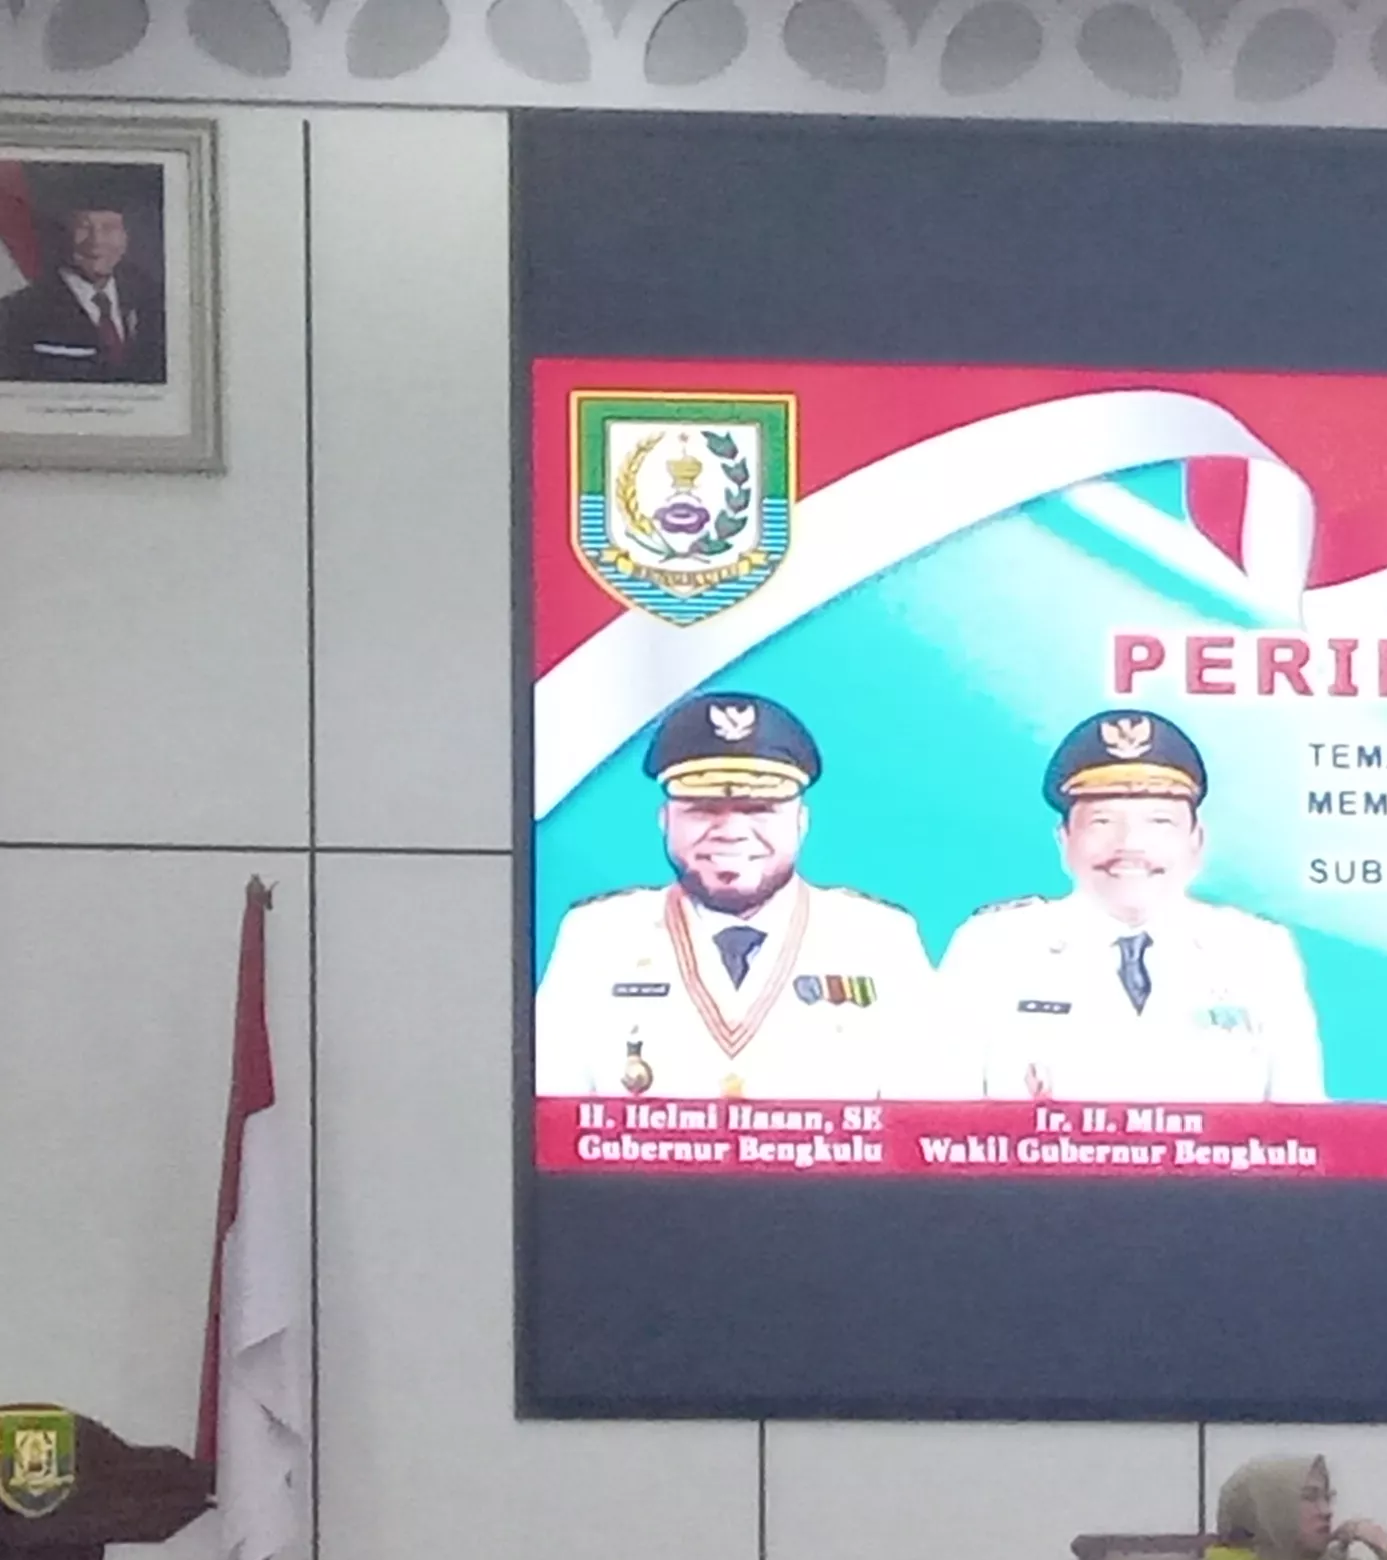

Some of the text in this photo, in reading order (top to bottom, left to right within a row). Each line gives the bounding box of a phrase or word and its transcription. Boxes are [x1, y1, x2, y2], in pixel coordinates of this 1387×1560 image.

[1309, 859, 1382, 884] SUB
[579, 1103, 616, 1129] H.
[625, 1104, 717, 1131] Helmi
[728, 1105, 834, 1134] Hasan,
[1034, 1108, 1204, 1133] Ir. H. Mian
[578, 1135, 883, 1169] Gubernur Bengkulu
[919, 1137, 1318, 1170] Wakil Gubernur Bengkulu
